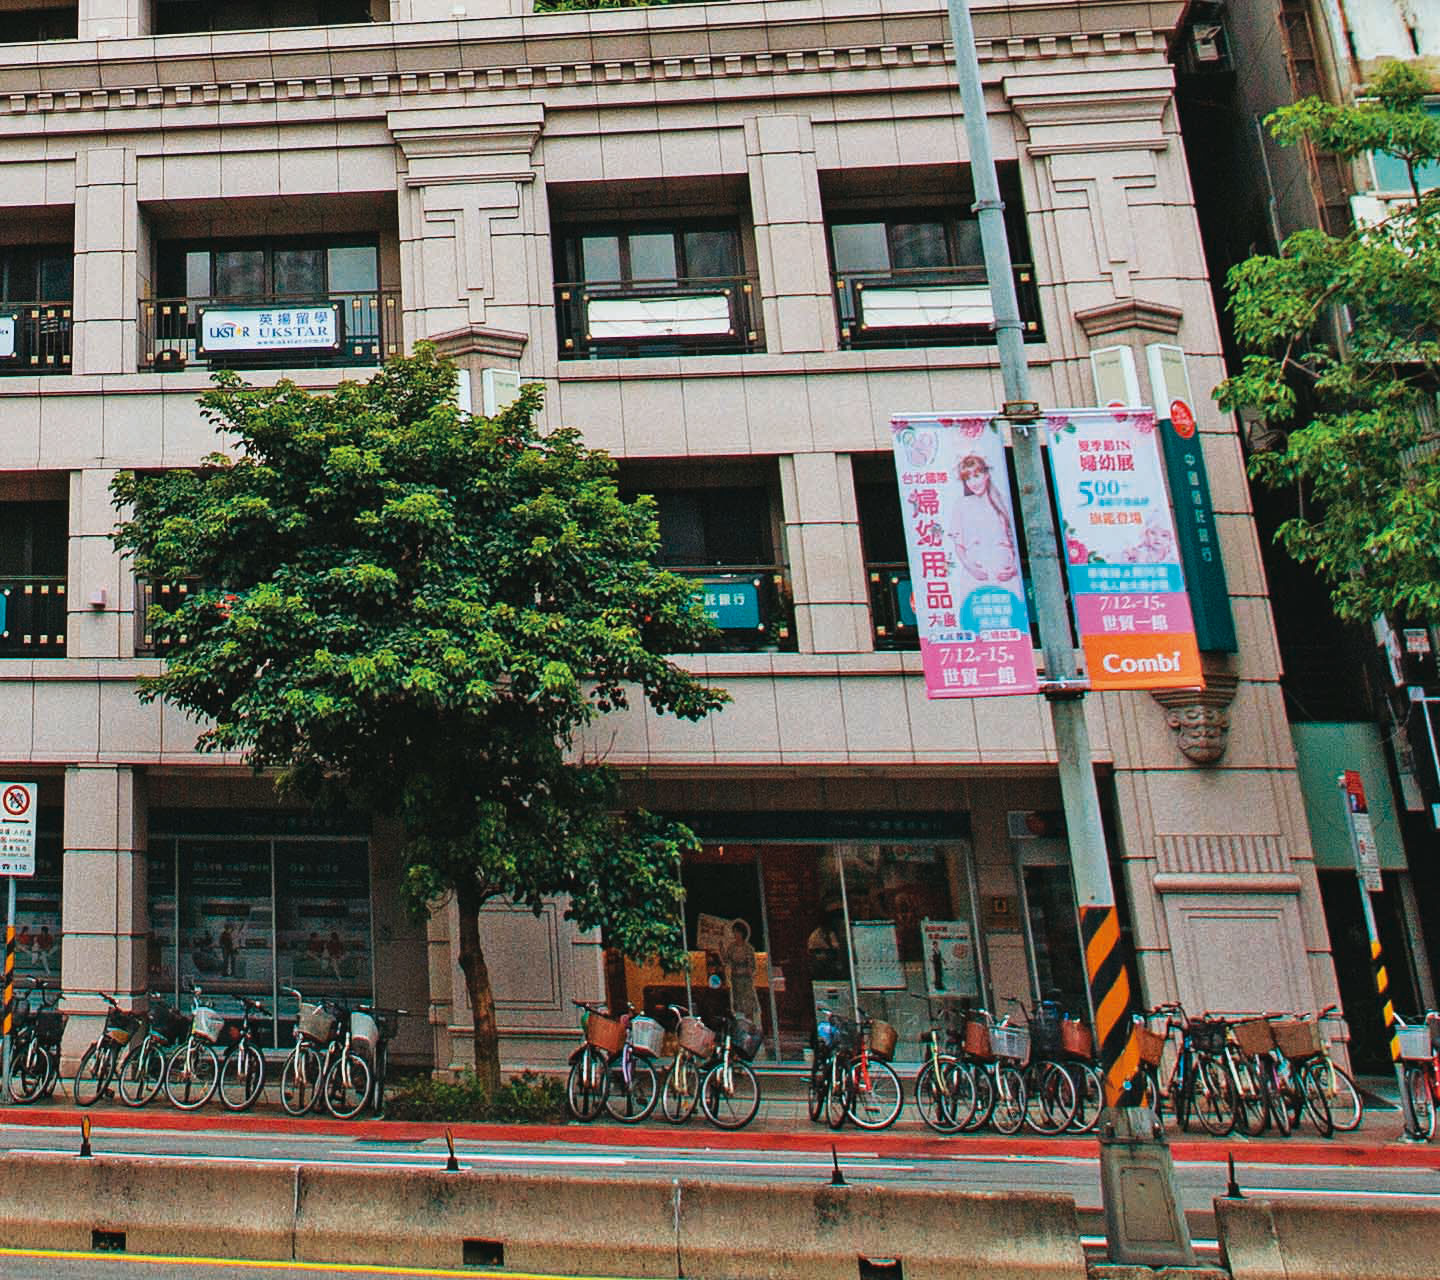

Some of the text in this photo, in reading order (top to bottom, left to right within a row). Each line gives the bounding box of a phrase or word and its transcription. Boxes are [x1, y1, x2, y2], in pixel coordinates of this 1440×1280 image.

[258, 326, 329, 338] UKSTAR
[1102, 651, 1181, 674] Combi
[941, 666, 1018, 687] 世貿一館
